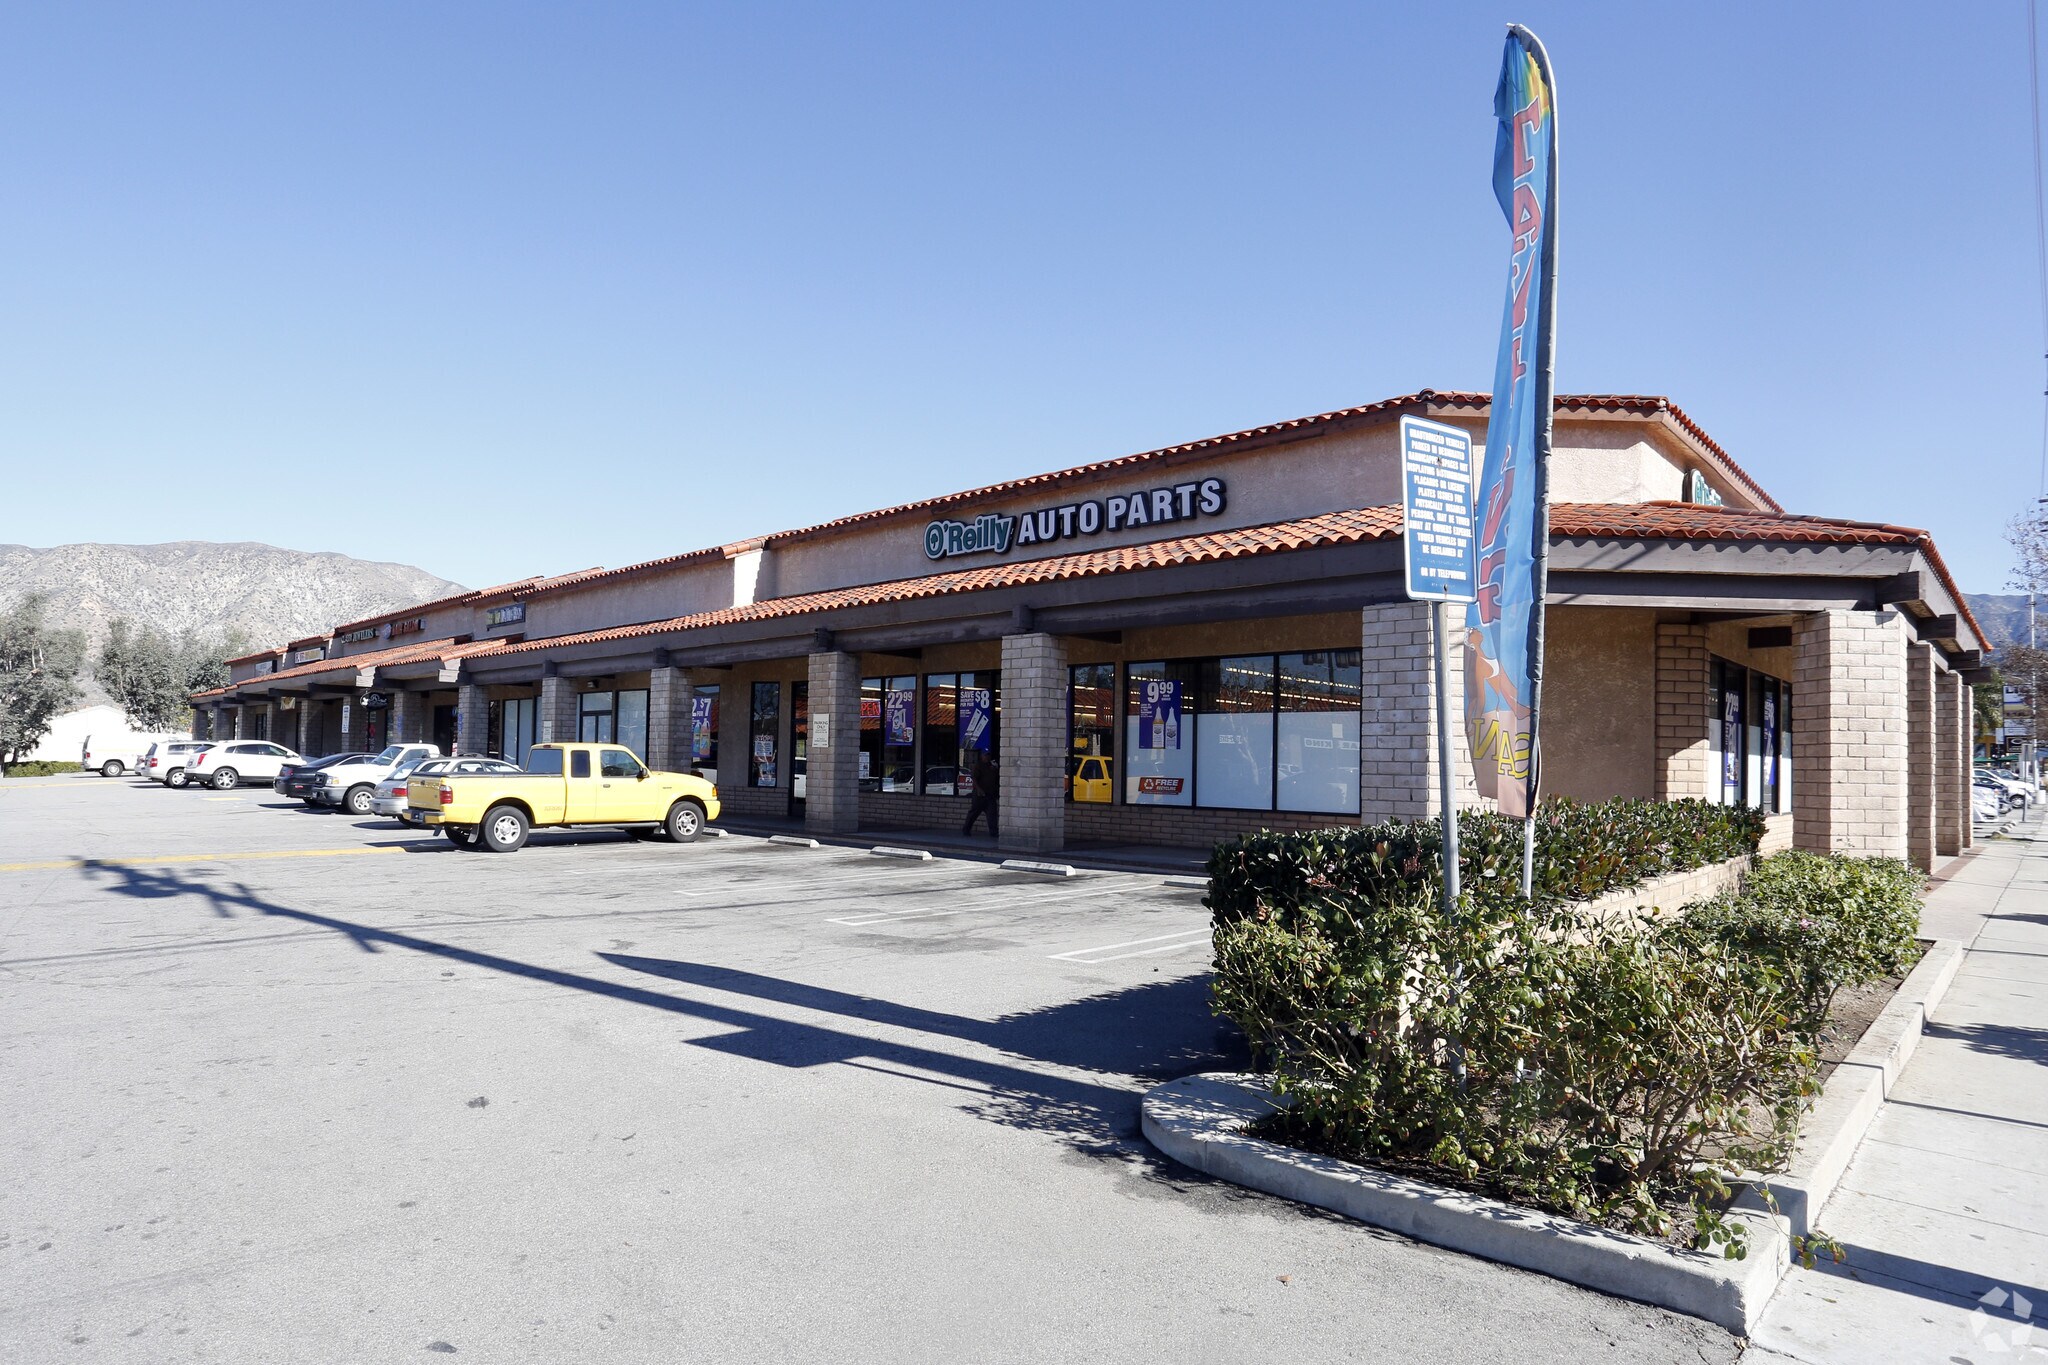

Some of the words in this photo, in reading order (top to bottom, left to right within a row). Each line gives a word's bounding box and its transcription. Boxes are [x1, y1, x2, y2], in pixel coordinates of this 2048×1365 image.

[1446, 437, 1466, 450] VEHICLES
[1442, 458, 1458, 470] SPACES
[1414, 474, 1438, 488] PLACARDS
[1448, 481, 1466, 493] LICENSE
[1418, 486, 1436, 498] PLATES
[1437, 490, 1453, 501] ISSUED
[1415, 498, 1443, 510] PHYSICALLY
[924, 514, 1014, 560] O'Reilly
[1018, 500, 1102, 546] AUTO
[1108, 478, 1225, 531] PARTS
[1409, 520, 1423, 530] AWAY
[1425, 522, 1431, 530] AT
[1436, 512, 1447, 522] MAY
[1448, 515, 1455, 524] BE
[1455, 516, 1470, 526] TOWED
[1417, 532, 1434, 543] TOWED
[1436, 534, 1456, 546] VEHICLES
[1457, 538, 1467, 547] MAY
[1422, 544, 1430, 554] BE
[1431, 545, 1456, 556] RECLAIMED
[1457, 549, 1463, 558] AT
[1430, 568, 1436, 577] BY
[975, 691, 990, 708] $8
[861, 703, 880, 716] PEN
